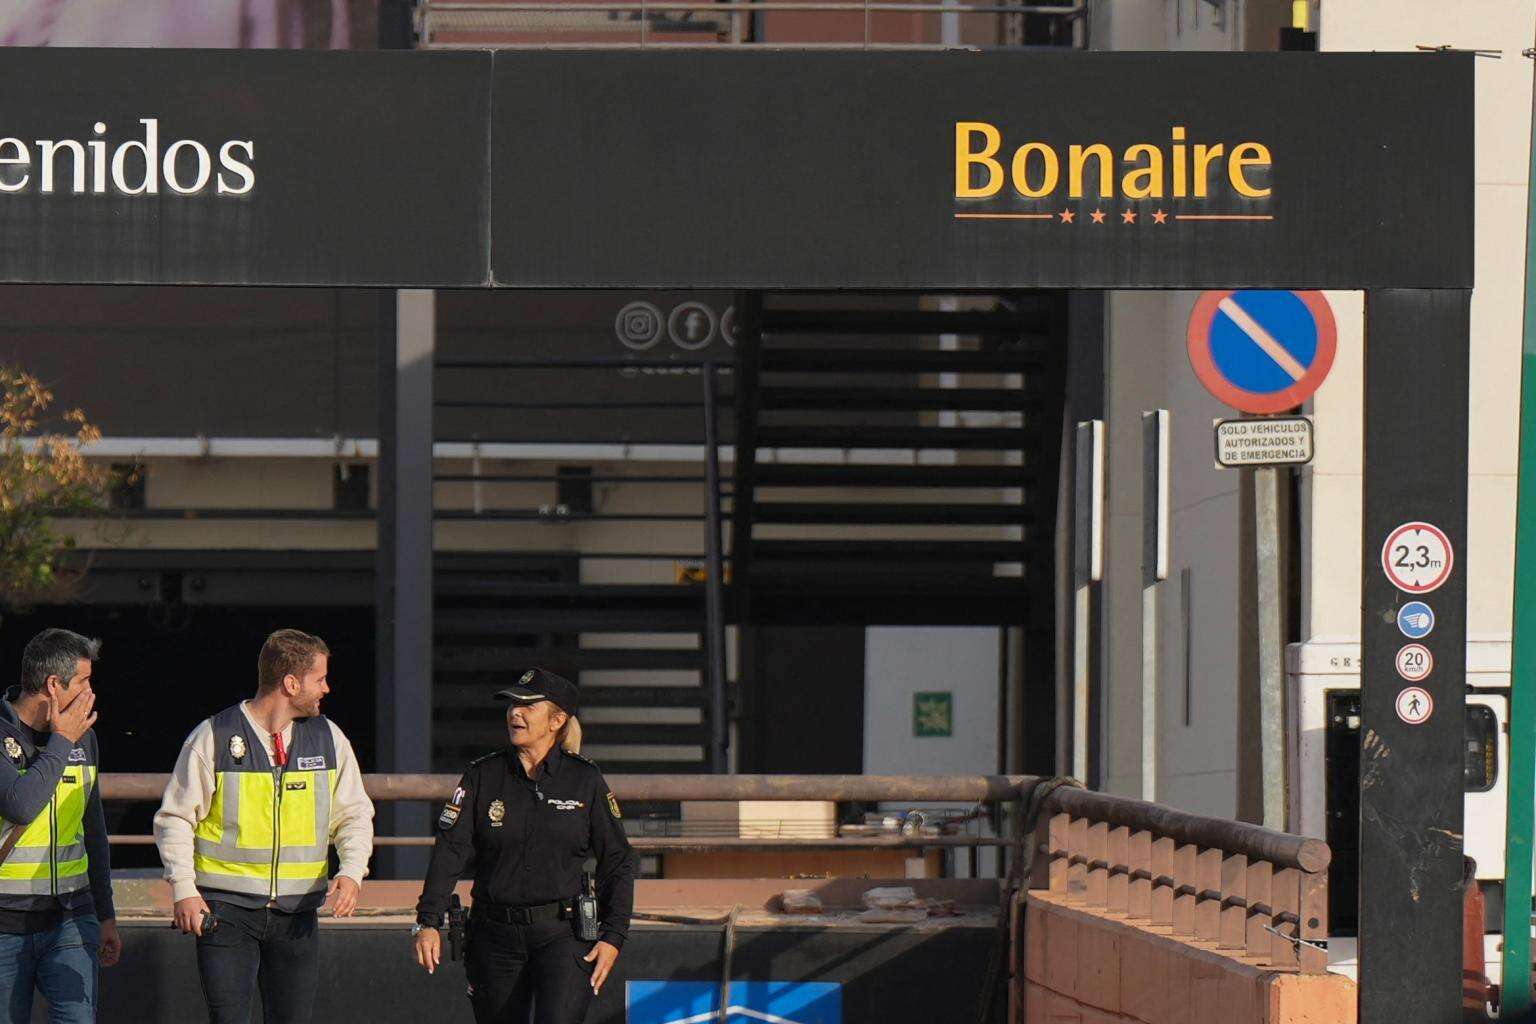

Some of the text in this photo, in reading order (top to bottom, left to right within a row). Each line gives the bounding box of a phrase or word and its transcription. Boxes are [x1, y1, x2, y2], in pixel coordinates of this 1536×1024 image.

[955, 122, 1272, 198] Bonaire
[1221, 423, 1306, 435] SOLO VEHICULOS
[1225, 437, 1304, 448] AUTORIZADOS Y
[1225, 449, 1305, 460] DE EMERGENCIA
[1405, 653, 1423, 667] 20
